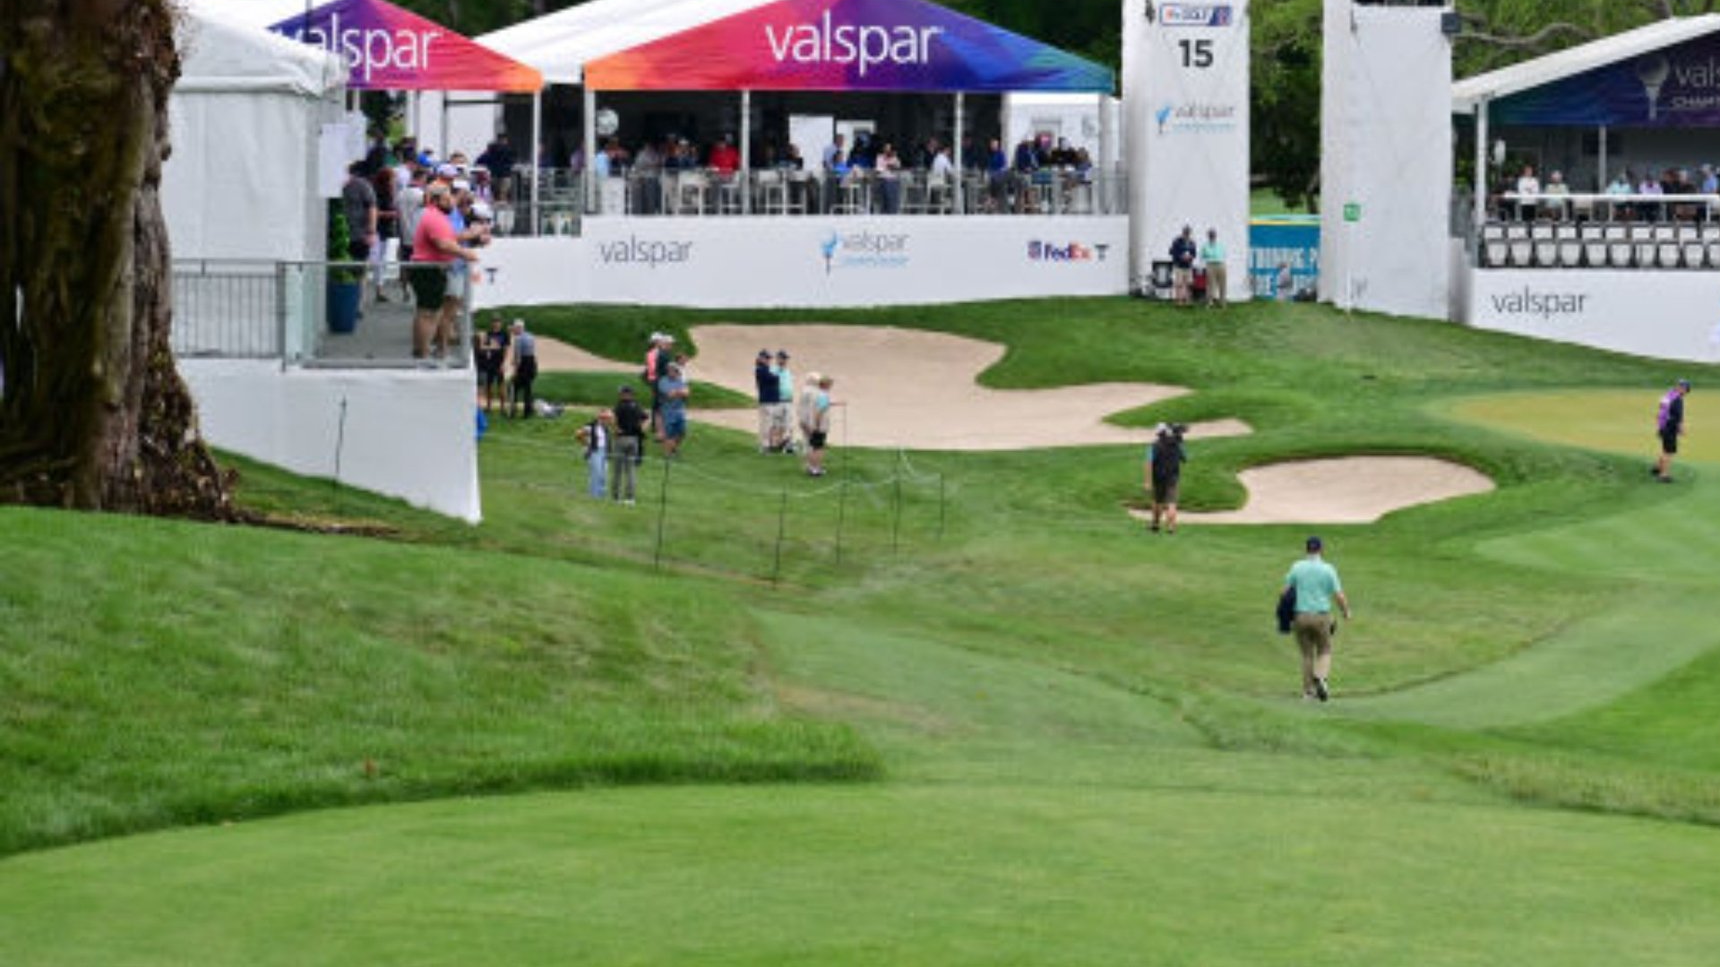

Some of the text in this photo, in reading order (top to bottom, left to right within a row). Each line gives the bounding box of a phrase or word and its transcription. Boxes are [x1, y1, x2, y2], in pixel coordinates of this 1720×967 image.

[277, 11, 442, 81] alspar
[765, 8, 943, 77] valspar
[1178, 38, 1213, 68] 15
[599, 232, 693, 268] valspar
[1491, 284, 1587, 319] valspar
